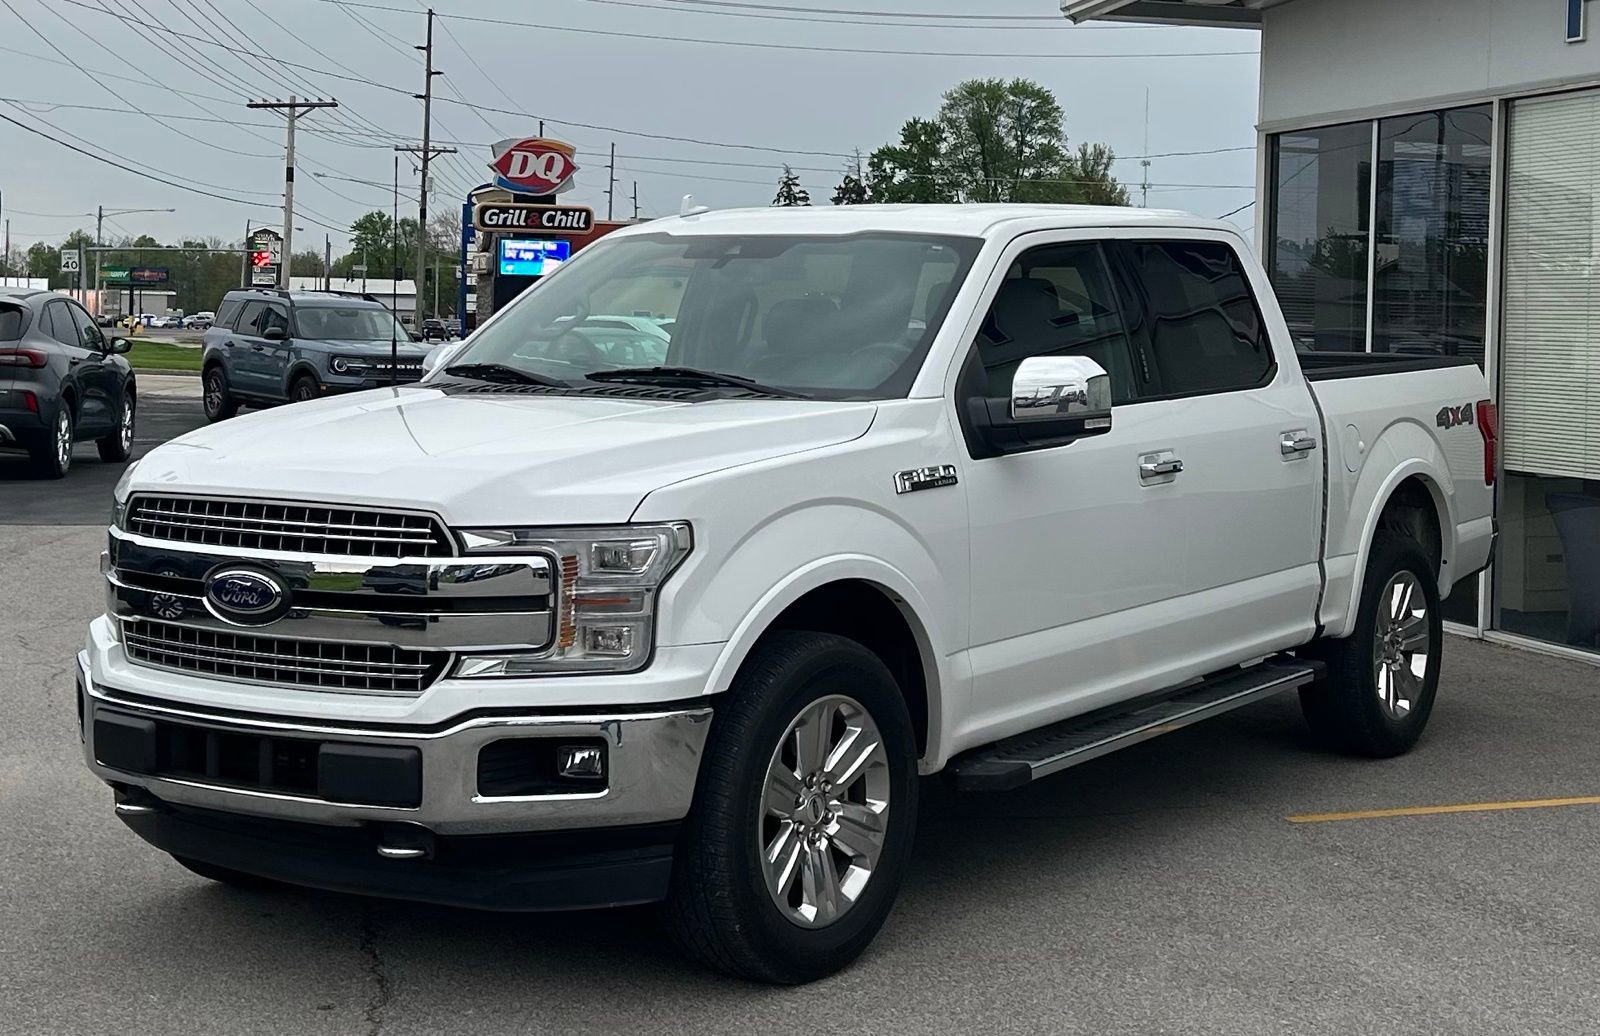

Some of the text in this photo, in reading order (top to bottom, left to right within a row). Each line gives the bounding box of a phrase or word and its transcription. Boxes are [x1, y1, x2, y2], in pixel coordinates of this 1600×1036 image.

[507, 150, 565, 184] DQ
[484, 208, 527, 226] Grill
[542, 210, 587, 228] Chill
[62, 260, 78, 269] 40
[221, 579, 262, 605] Ford
